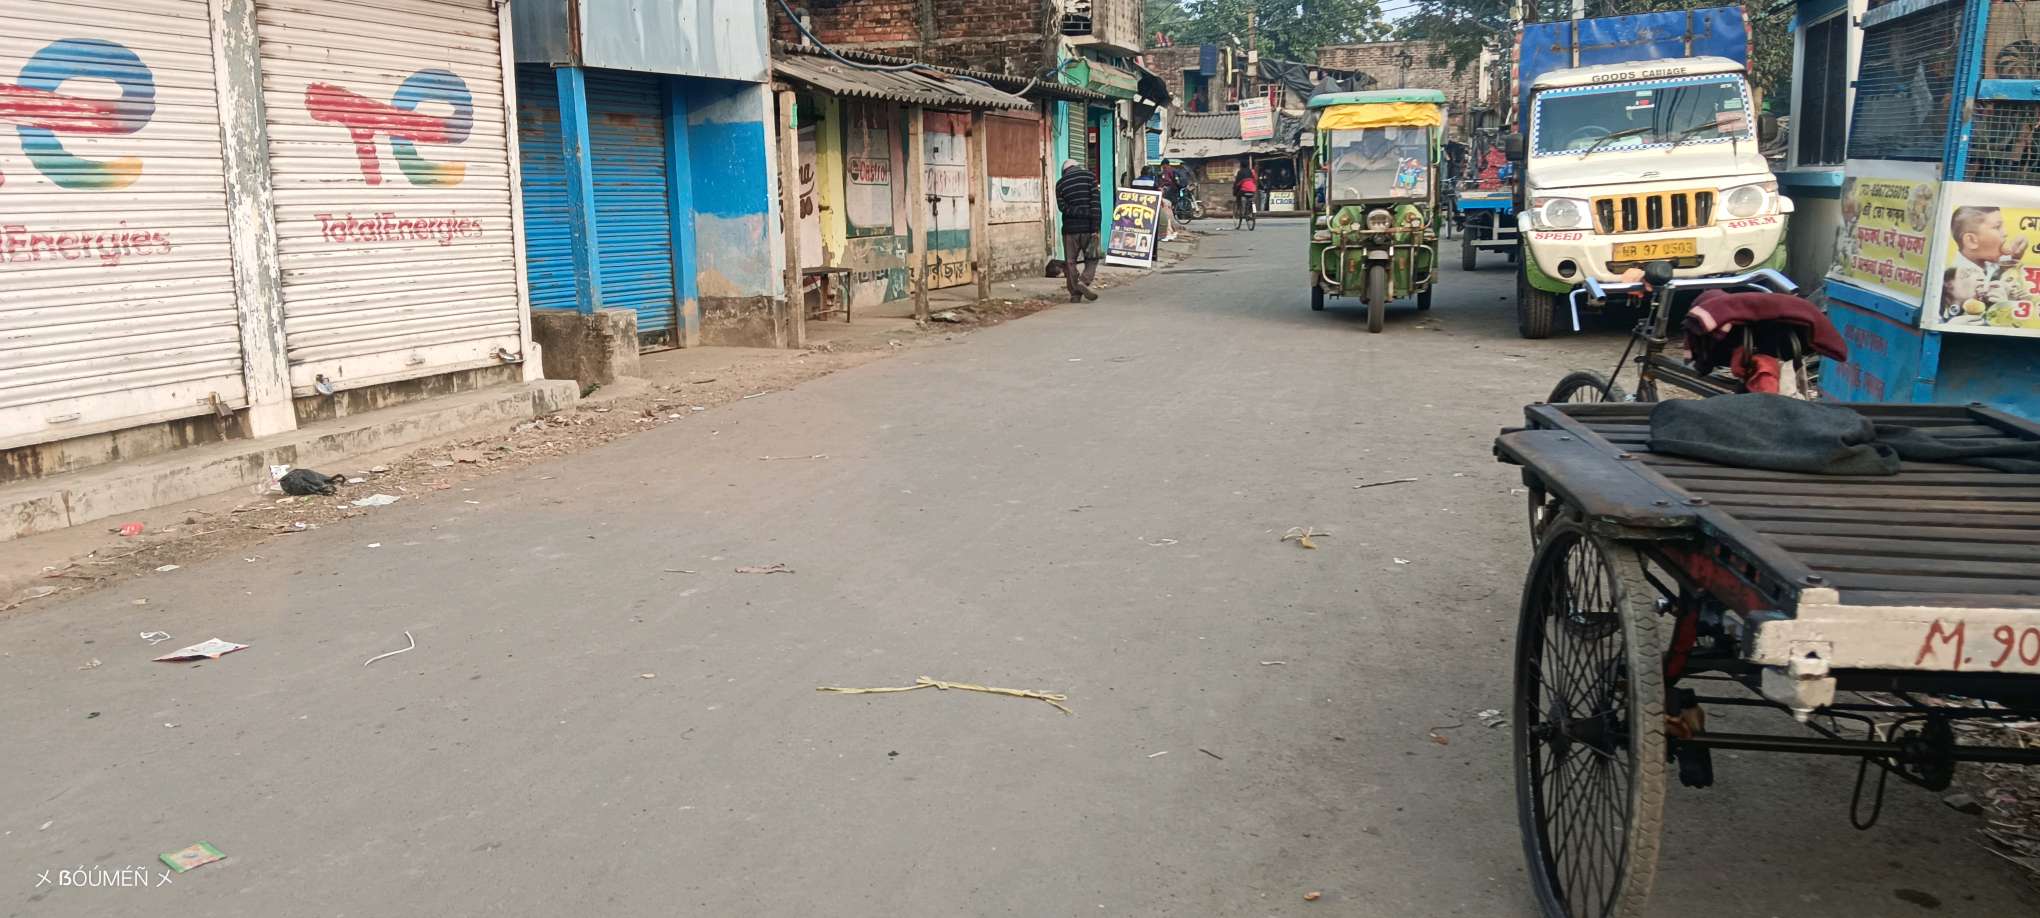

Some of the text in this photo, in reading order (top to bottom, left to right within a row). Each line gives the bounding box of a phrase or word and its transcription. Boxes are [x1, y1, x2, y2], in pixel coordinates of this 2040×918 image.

[1592, 71, 1637, 83] GOODS
[1113, 203, 1155, 228] সেলুন
[314, 209, 483, 246] TotalEnergies
[1534, 232, 1583, 241] SPEED
